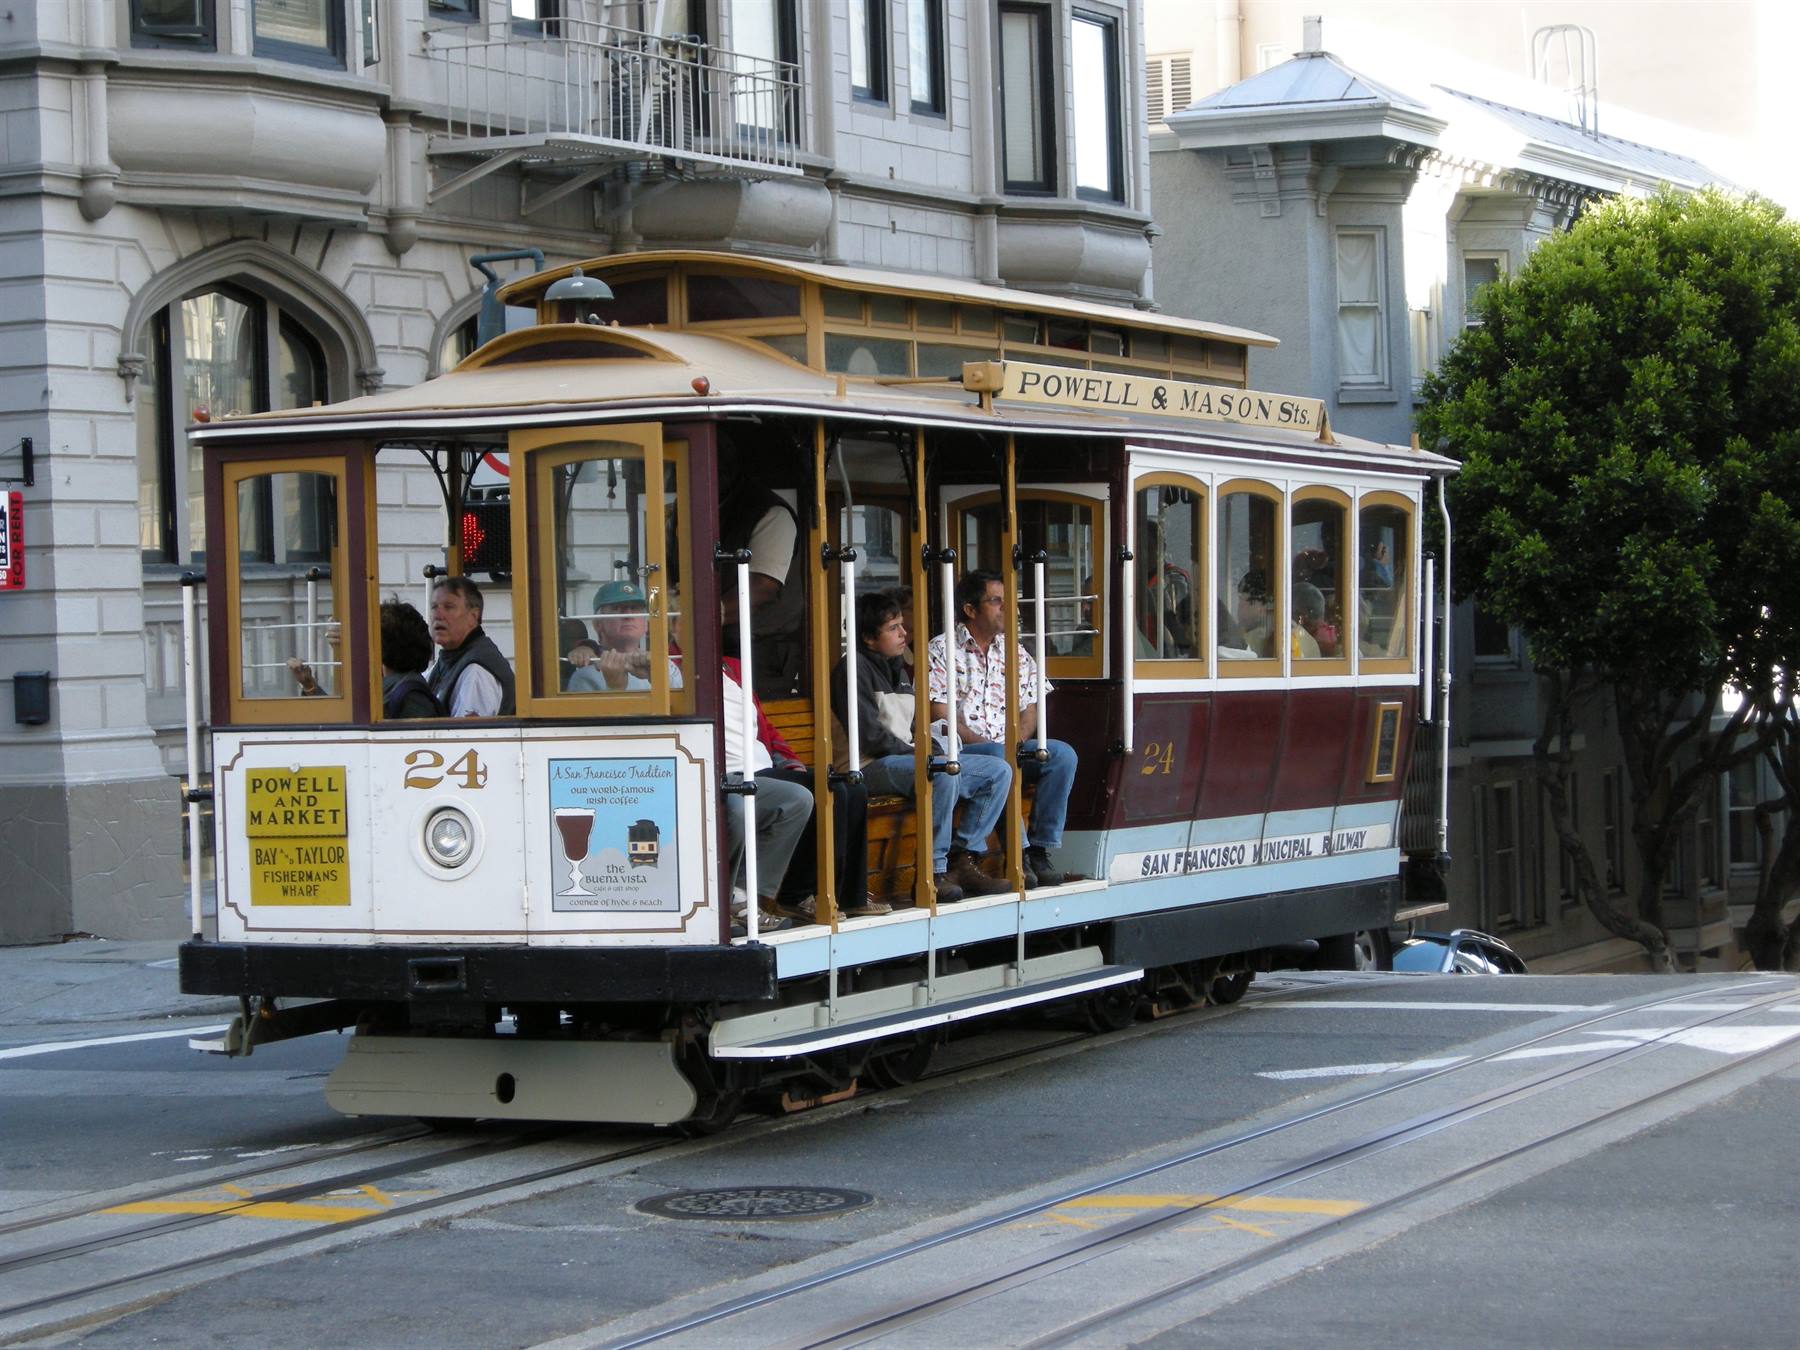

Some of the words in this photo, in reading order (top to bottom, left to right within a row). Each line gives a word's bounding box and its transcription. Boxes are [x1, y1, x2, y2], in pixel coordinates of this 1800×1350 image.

[1018, 371, 1139, 407] POWELL
[1151, 385, 1168, 411] &
[1180, 388, 1272, 420] MASON
[1278, 400, 1311, 425] Sts.
[10, 498, 21, 543] RENT
[13, 550, 23, 586] FOR
[1140, 740, 1175, 776] 24
[403, 747, 488, 790] 24
[552, 766, 562, 780] A
[564, 766, 582, 779] San
[583, 765, 627, 780] Francisco
[629, 764, 673, 779] Tradition
[251, 777, 339, 794] POWELL
[274, 795, 318, 808] AND
[250, 809, 341, 825] MARKET
[255, 847, 278, 865] BAY
[295, 846, 345, 865] TAYLOR
[1141, 854, 1170, 877] SAN
[1174, 843, 1246, 874] FRANCISCO
[263, 869, 338, 883] FISHERMANS
[281, 884, 320, 897] WHARF
